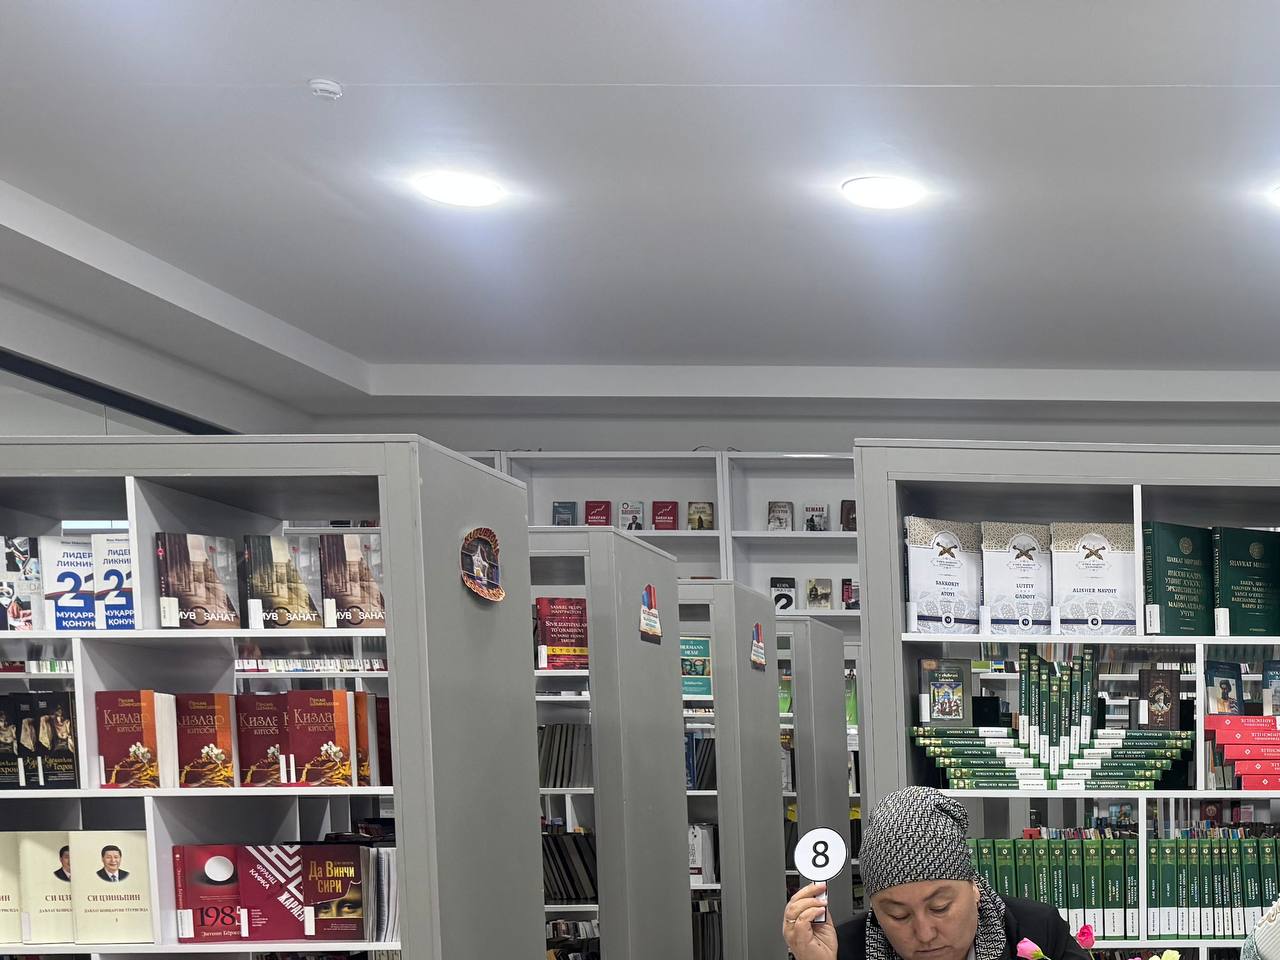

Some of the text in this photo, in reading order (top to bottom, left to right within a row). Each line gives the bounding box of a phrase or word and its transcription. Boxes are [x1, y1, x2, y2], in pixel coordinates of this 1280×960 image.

[56, 560, 94, 568] ЛИКНИН
[56, 611, 95, 620] МУҚАРР
[62, 620, 95, 628] ҚОНУН
[811, 840, 830, 869] 8
[309, 860, 355, 881] Да Винчи
[249, 868, 271, 890] КАФКА
